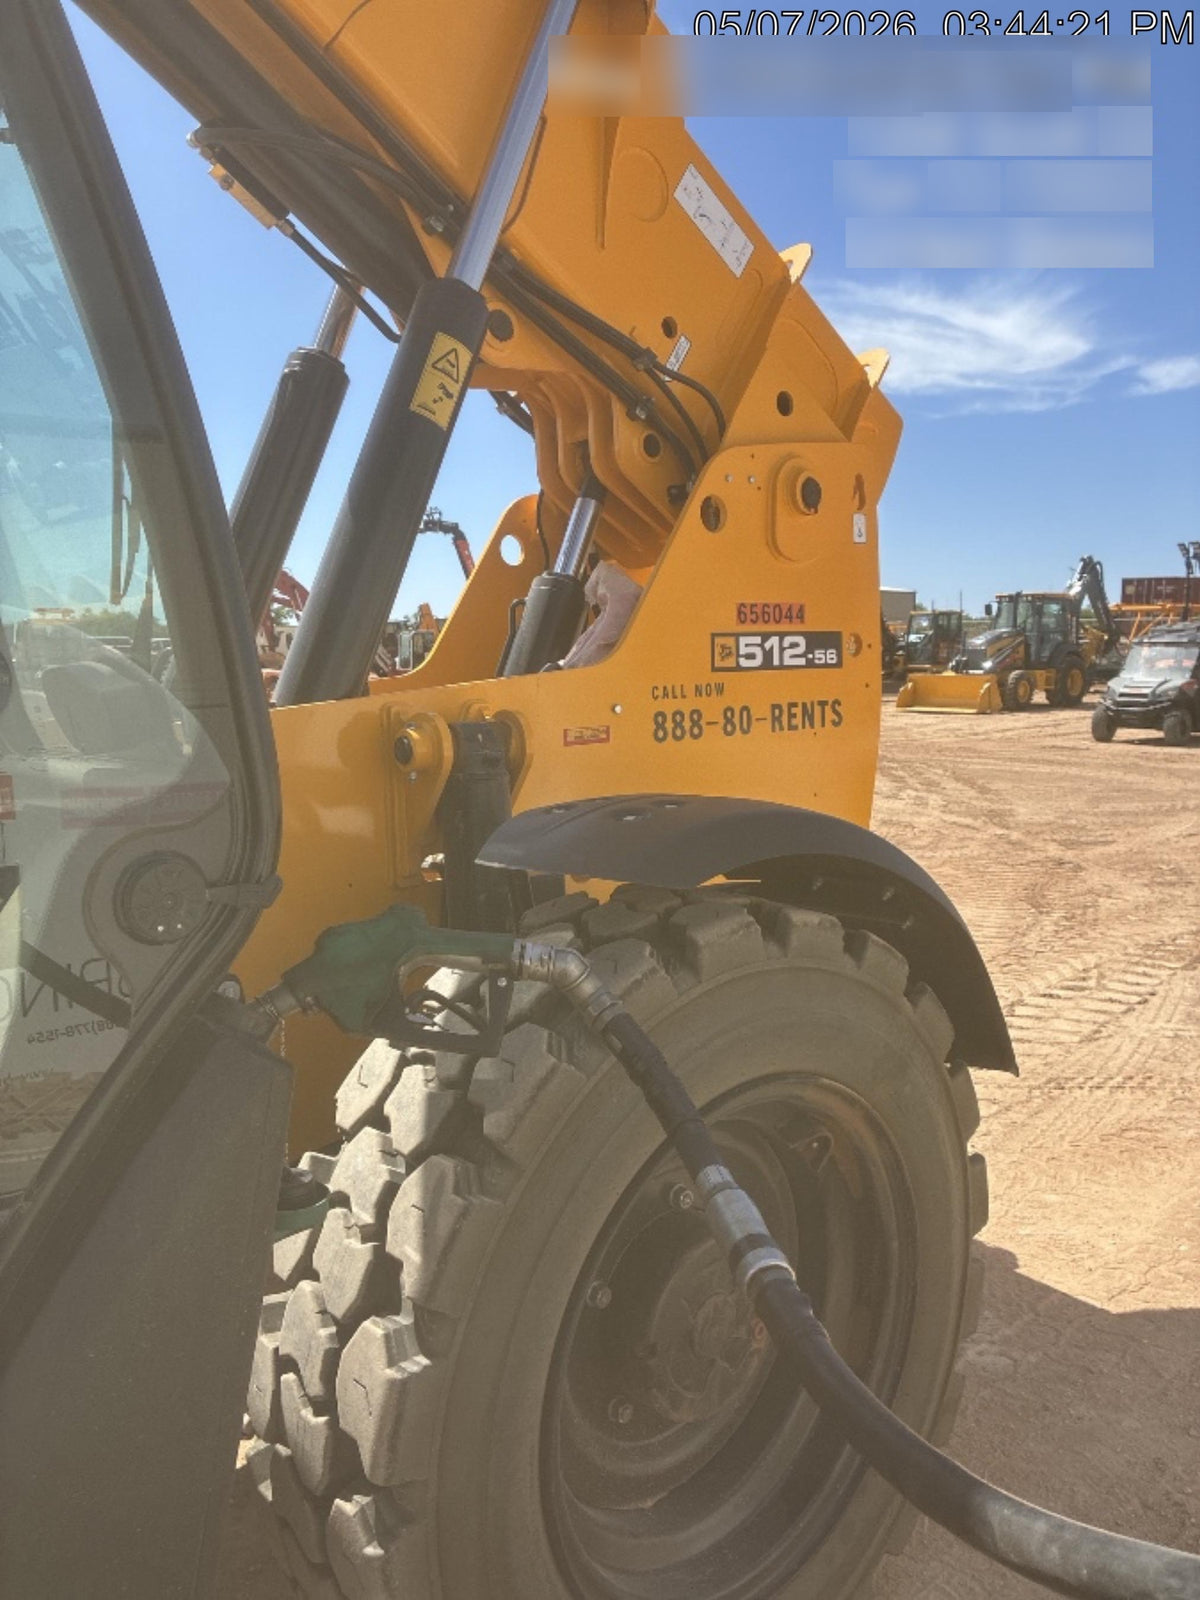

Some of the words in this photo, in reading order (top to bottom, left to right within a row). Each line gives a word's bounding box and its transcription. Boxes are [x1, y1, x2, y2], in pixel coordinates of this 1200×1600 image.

[737, 603, 804, 624] 656044
[651, 684, 687, 700] CALL
[694, 682, 725, 698] NOW
[653, 698, 844, 743] 888-80-RENTS
